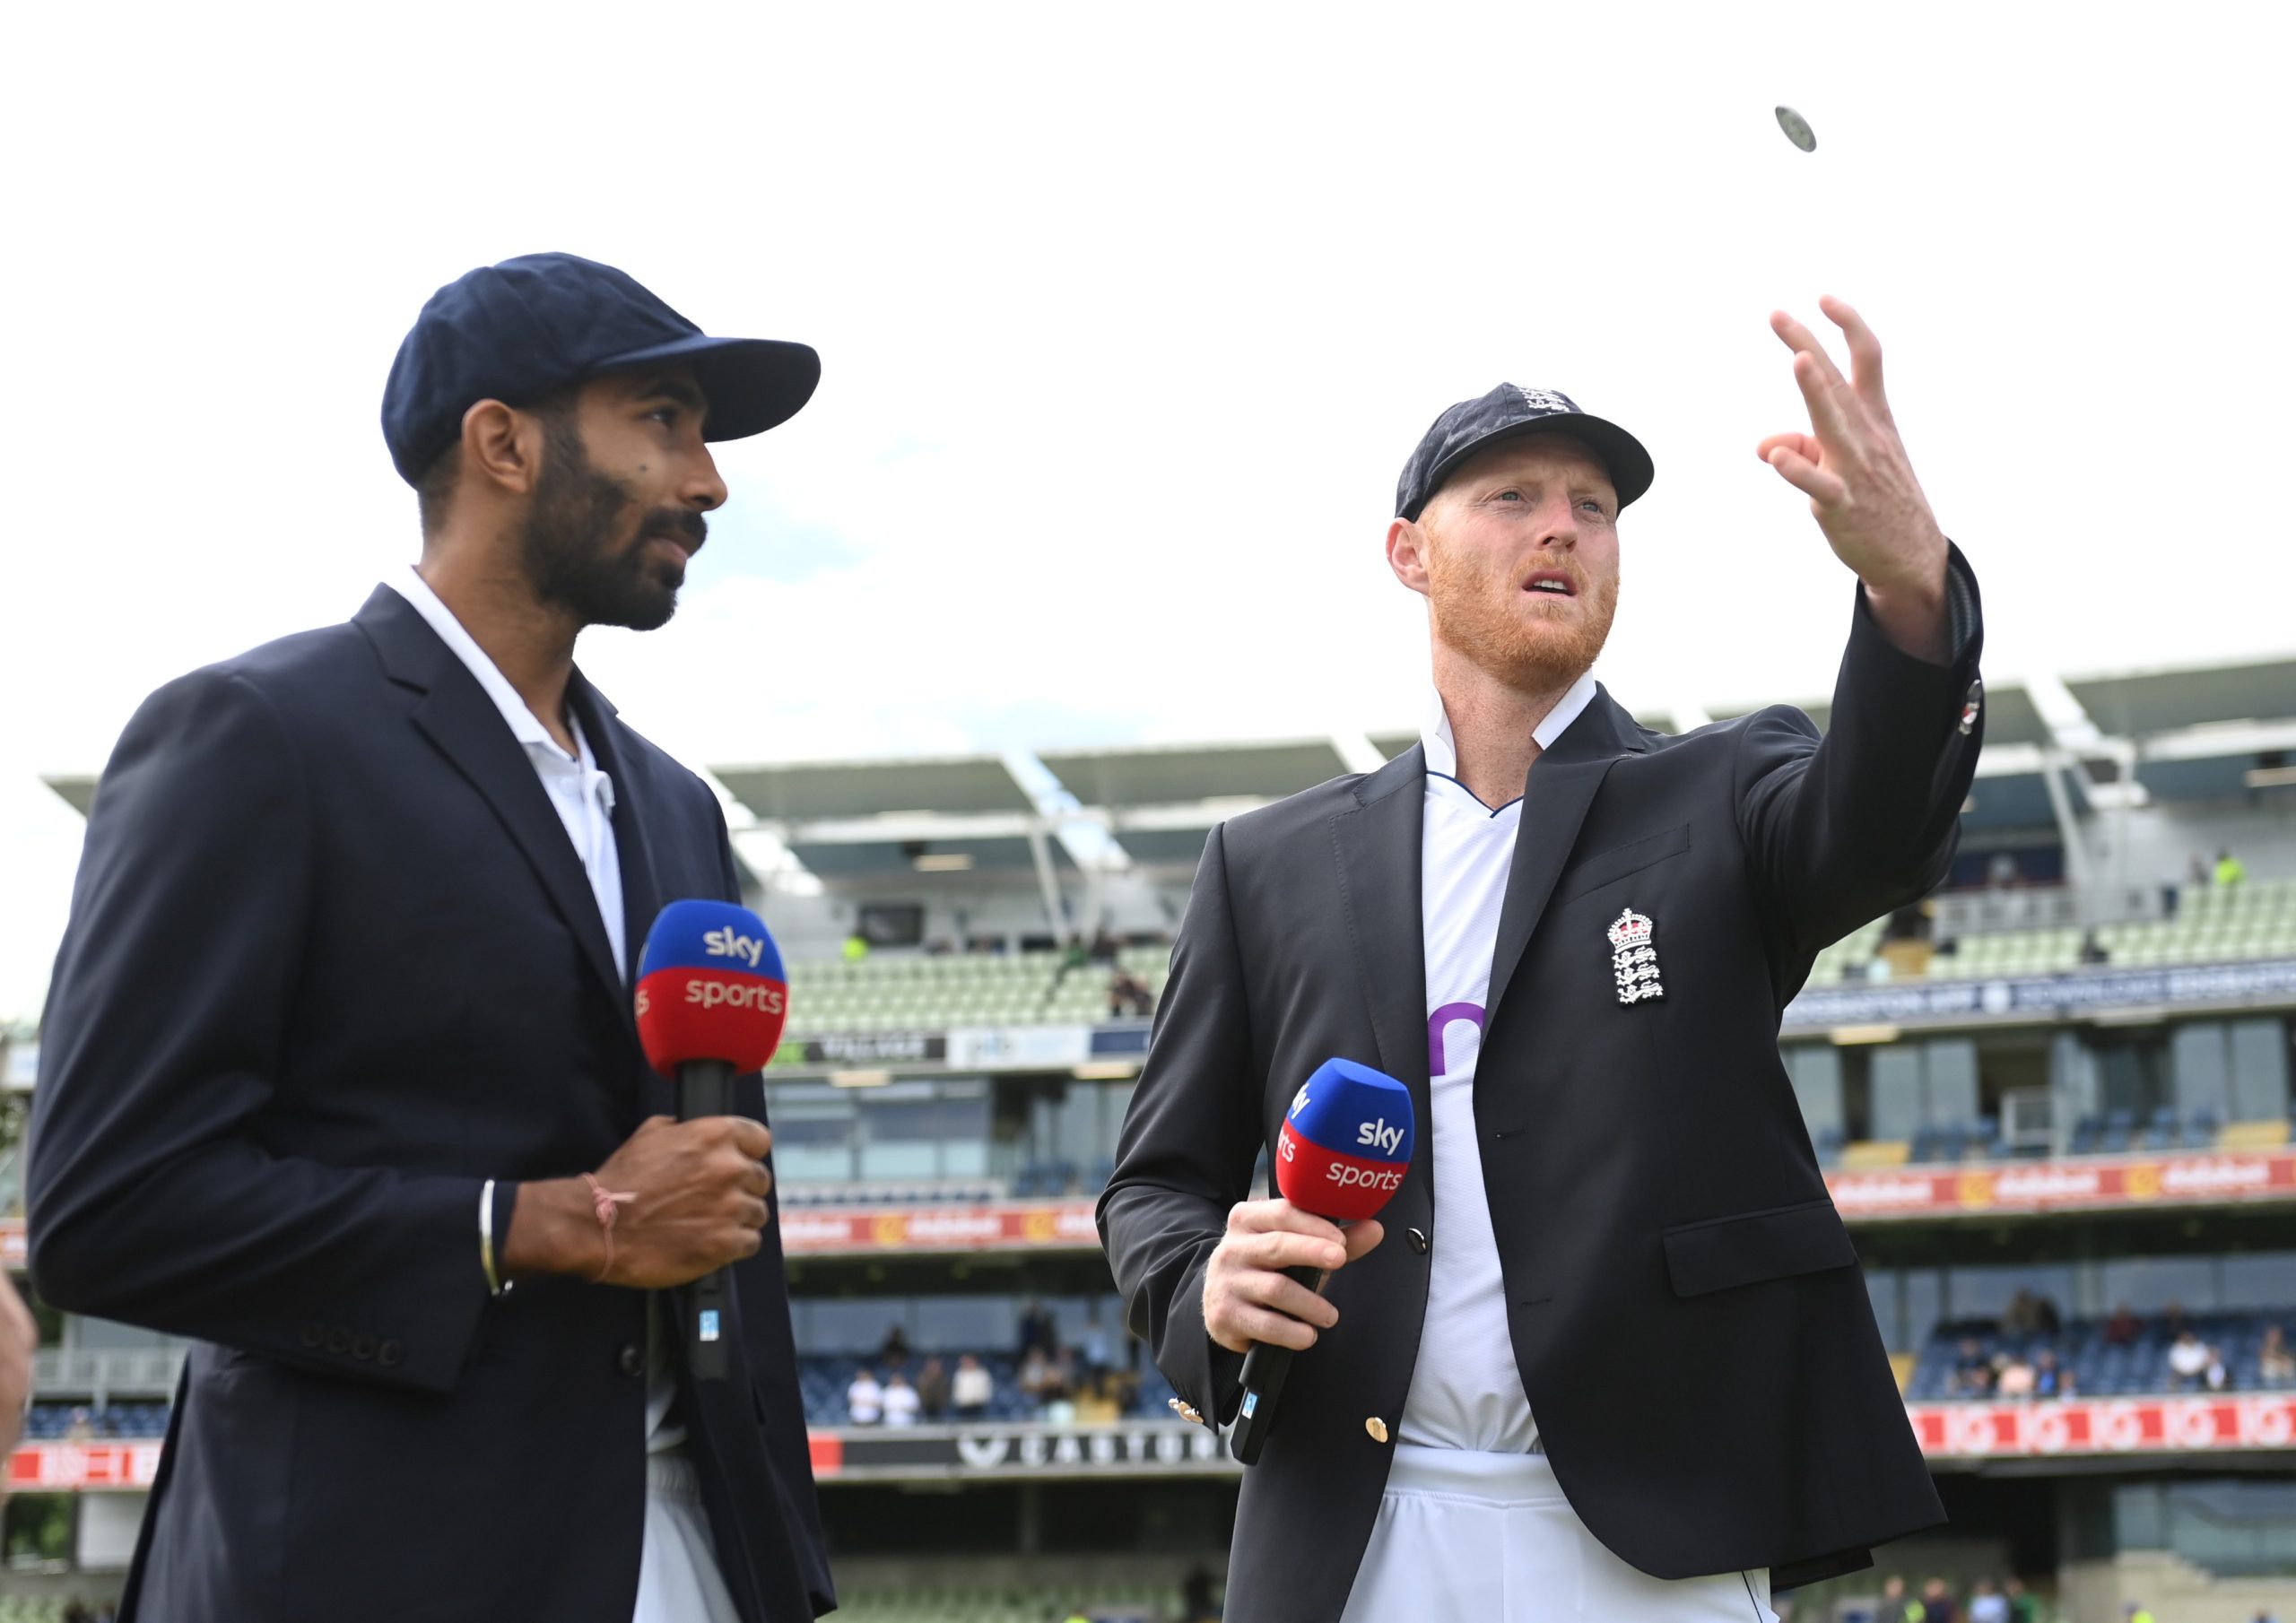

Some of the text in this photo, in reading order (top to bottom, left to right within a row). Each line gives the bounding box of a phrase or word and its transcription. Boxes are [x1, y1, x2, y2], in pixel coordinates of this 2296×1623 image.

[702, 925, 763, 968] sky
[684, 979, 783, 1015] sports
[1357, 1118, 1405, 1155] sky
[1326, 1162, 1402, 1190] sports
[1020, 1429, 1233, 1466] CASTOR
